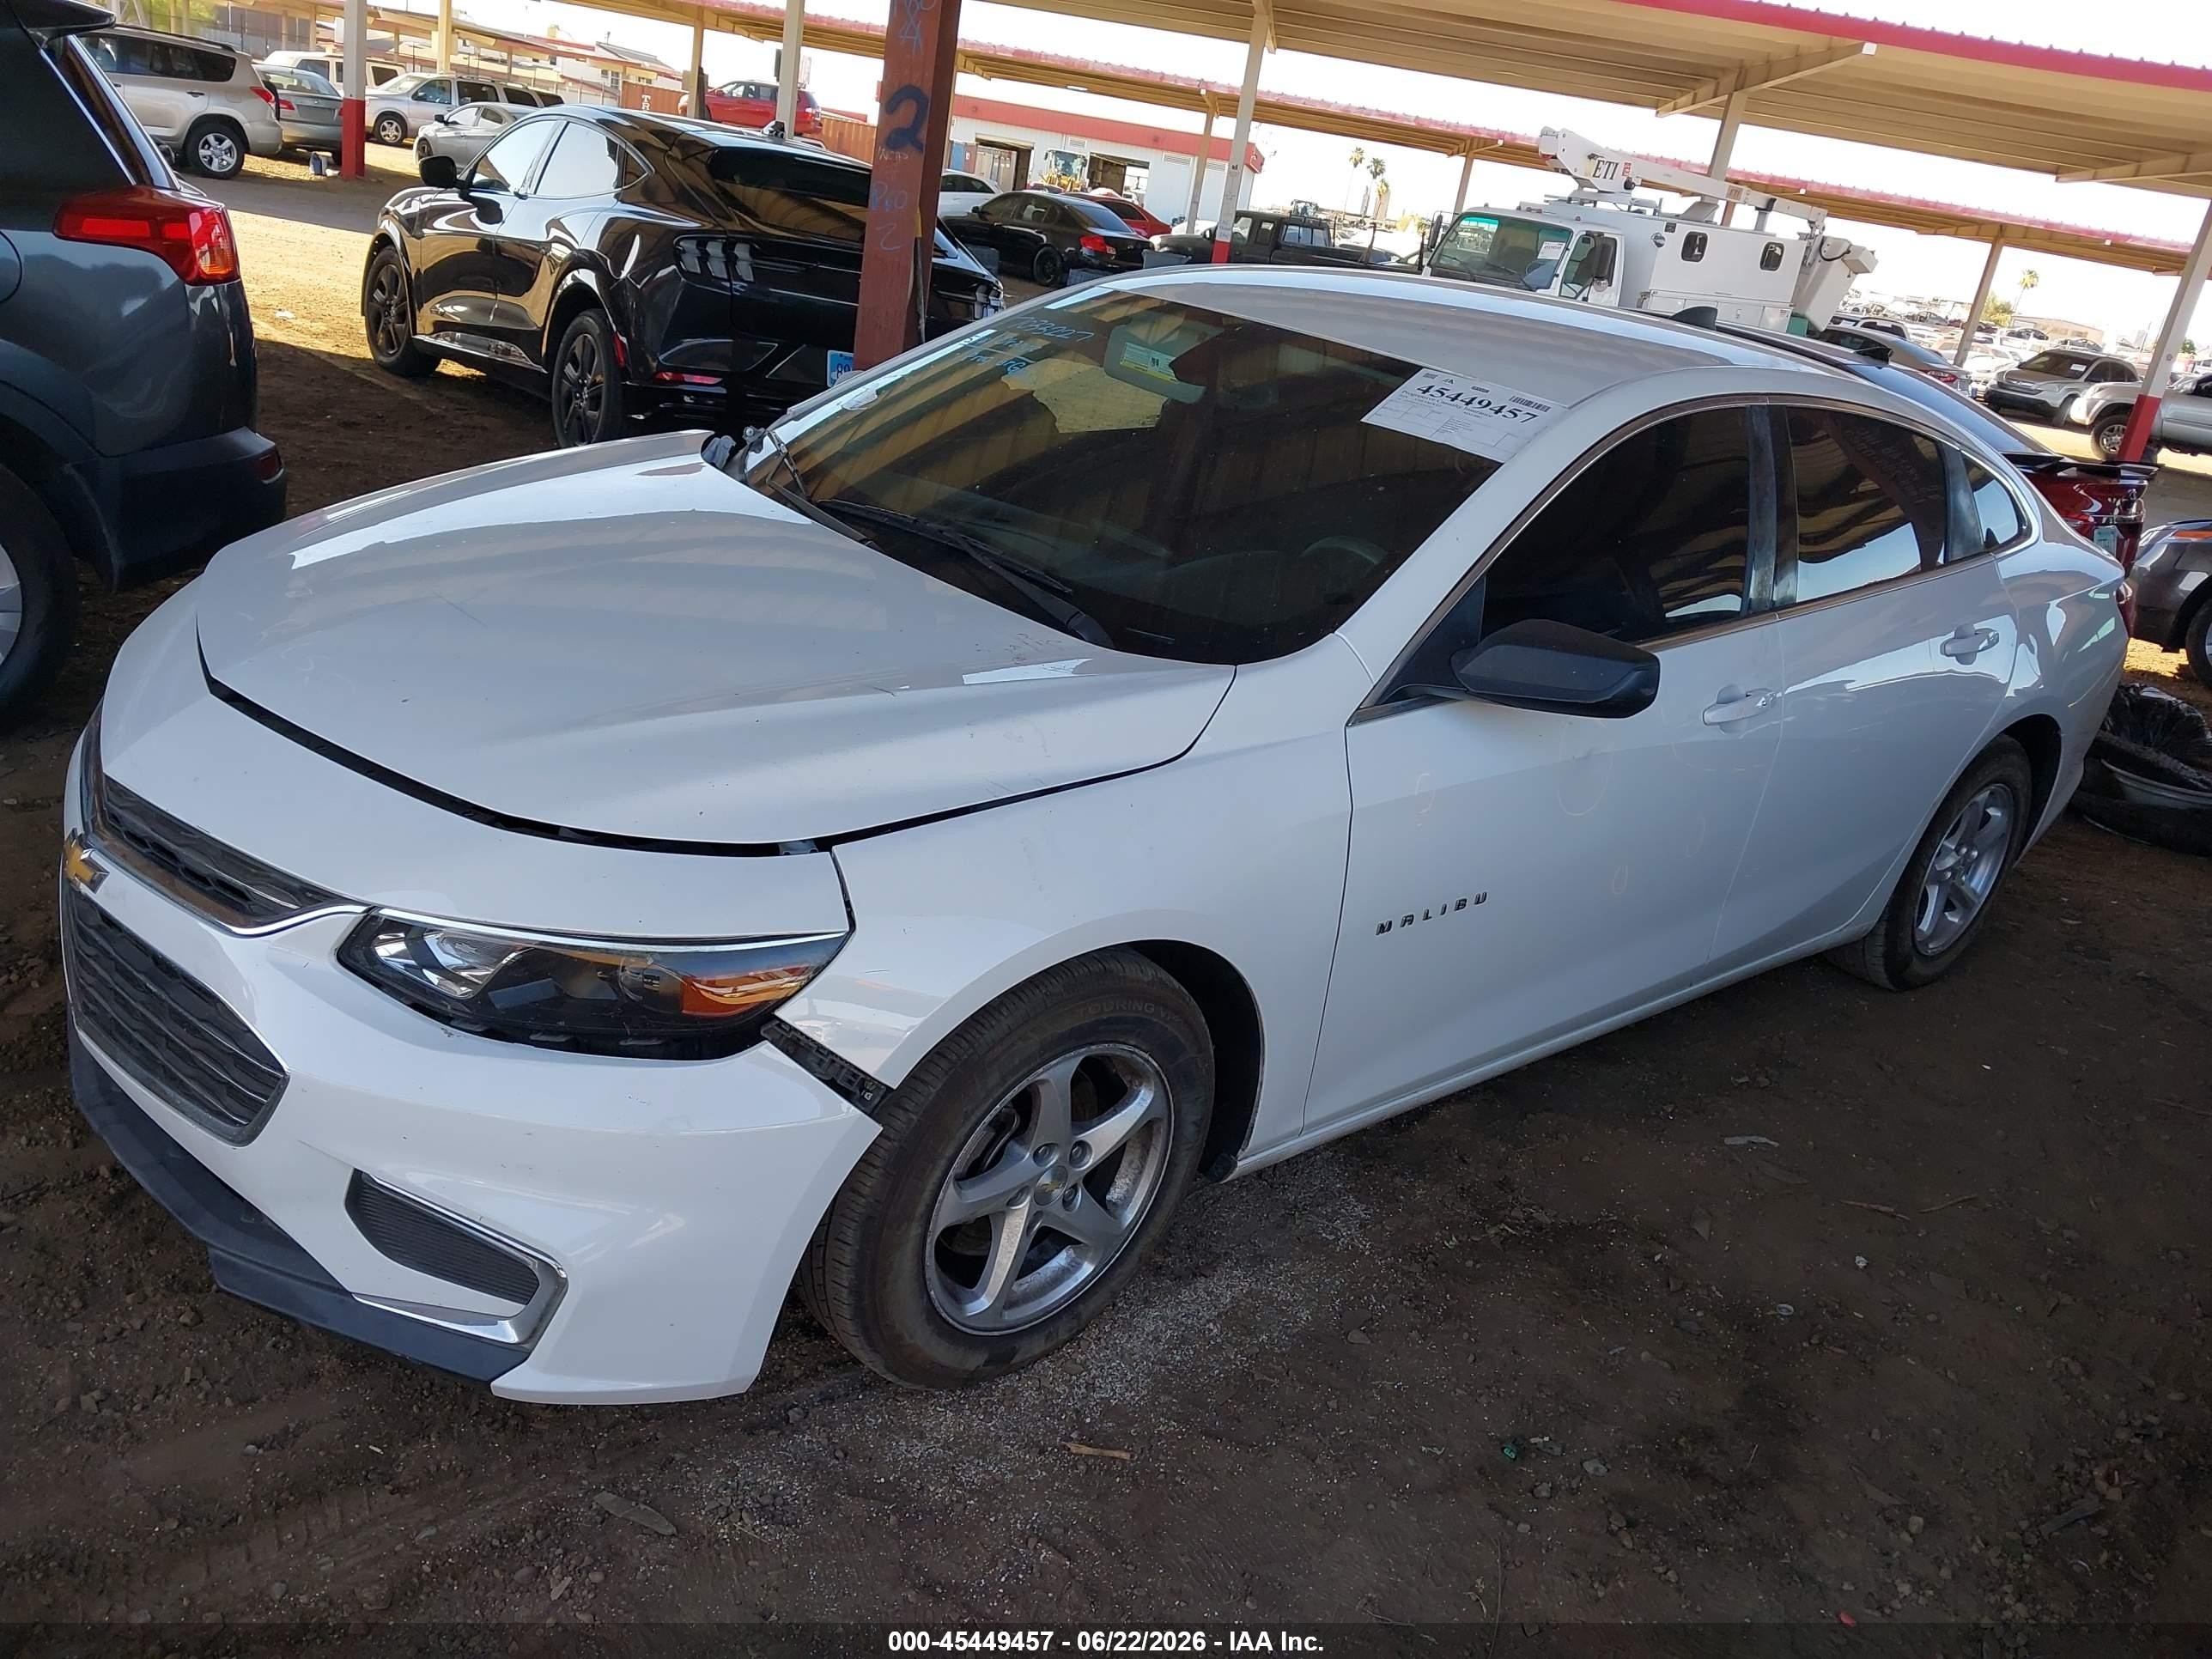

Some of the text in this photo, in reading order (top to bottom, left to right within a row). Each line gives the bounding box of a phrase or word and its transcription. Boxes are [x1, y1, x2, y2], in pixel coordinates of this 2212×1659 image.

[885, 84, 930, 152] 2
[1592, 159, 1620, 180] ETI
[1416, 384, 1540, 424] 45449457
[1376, 891, 1487, 936] MALIBU
